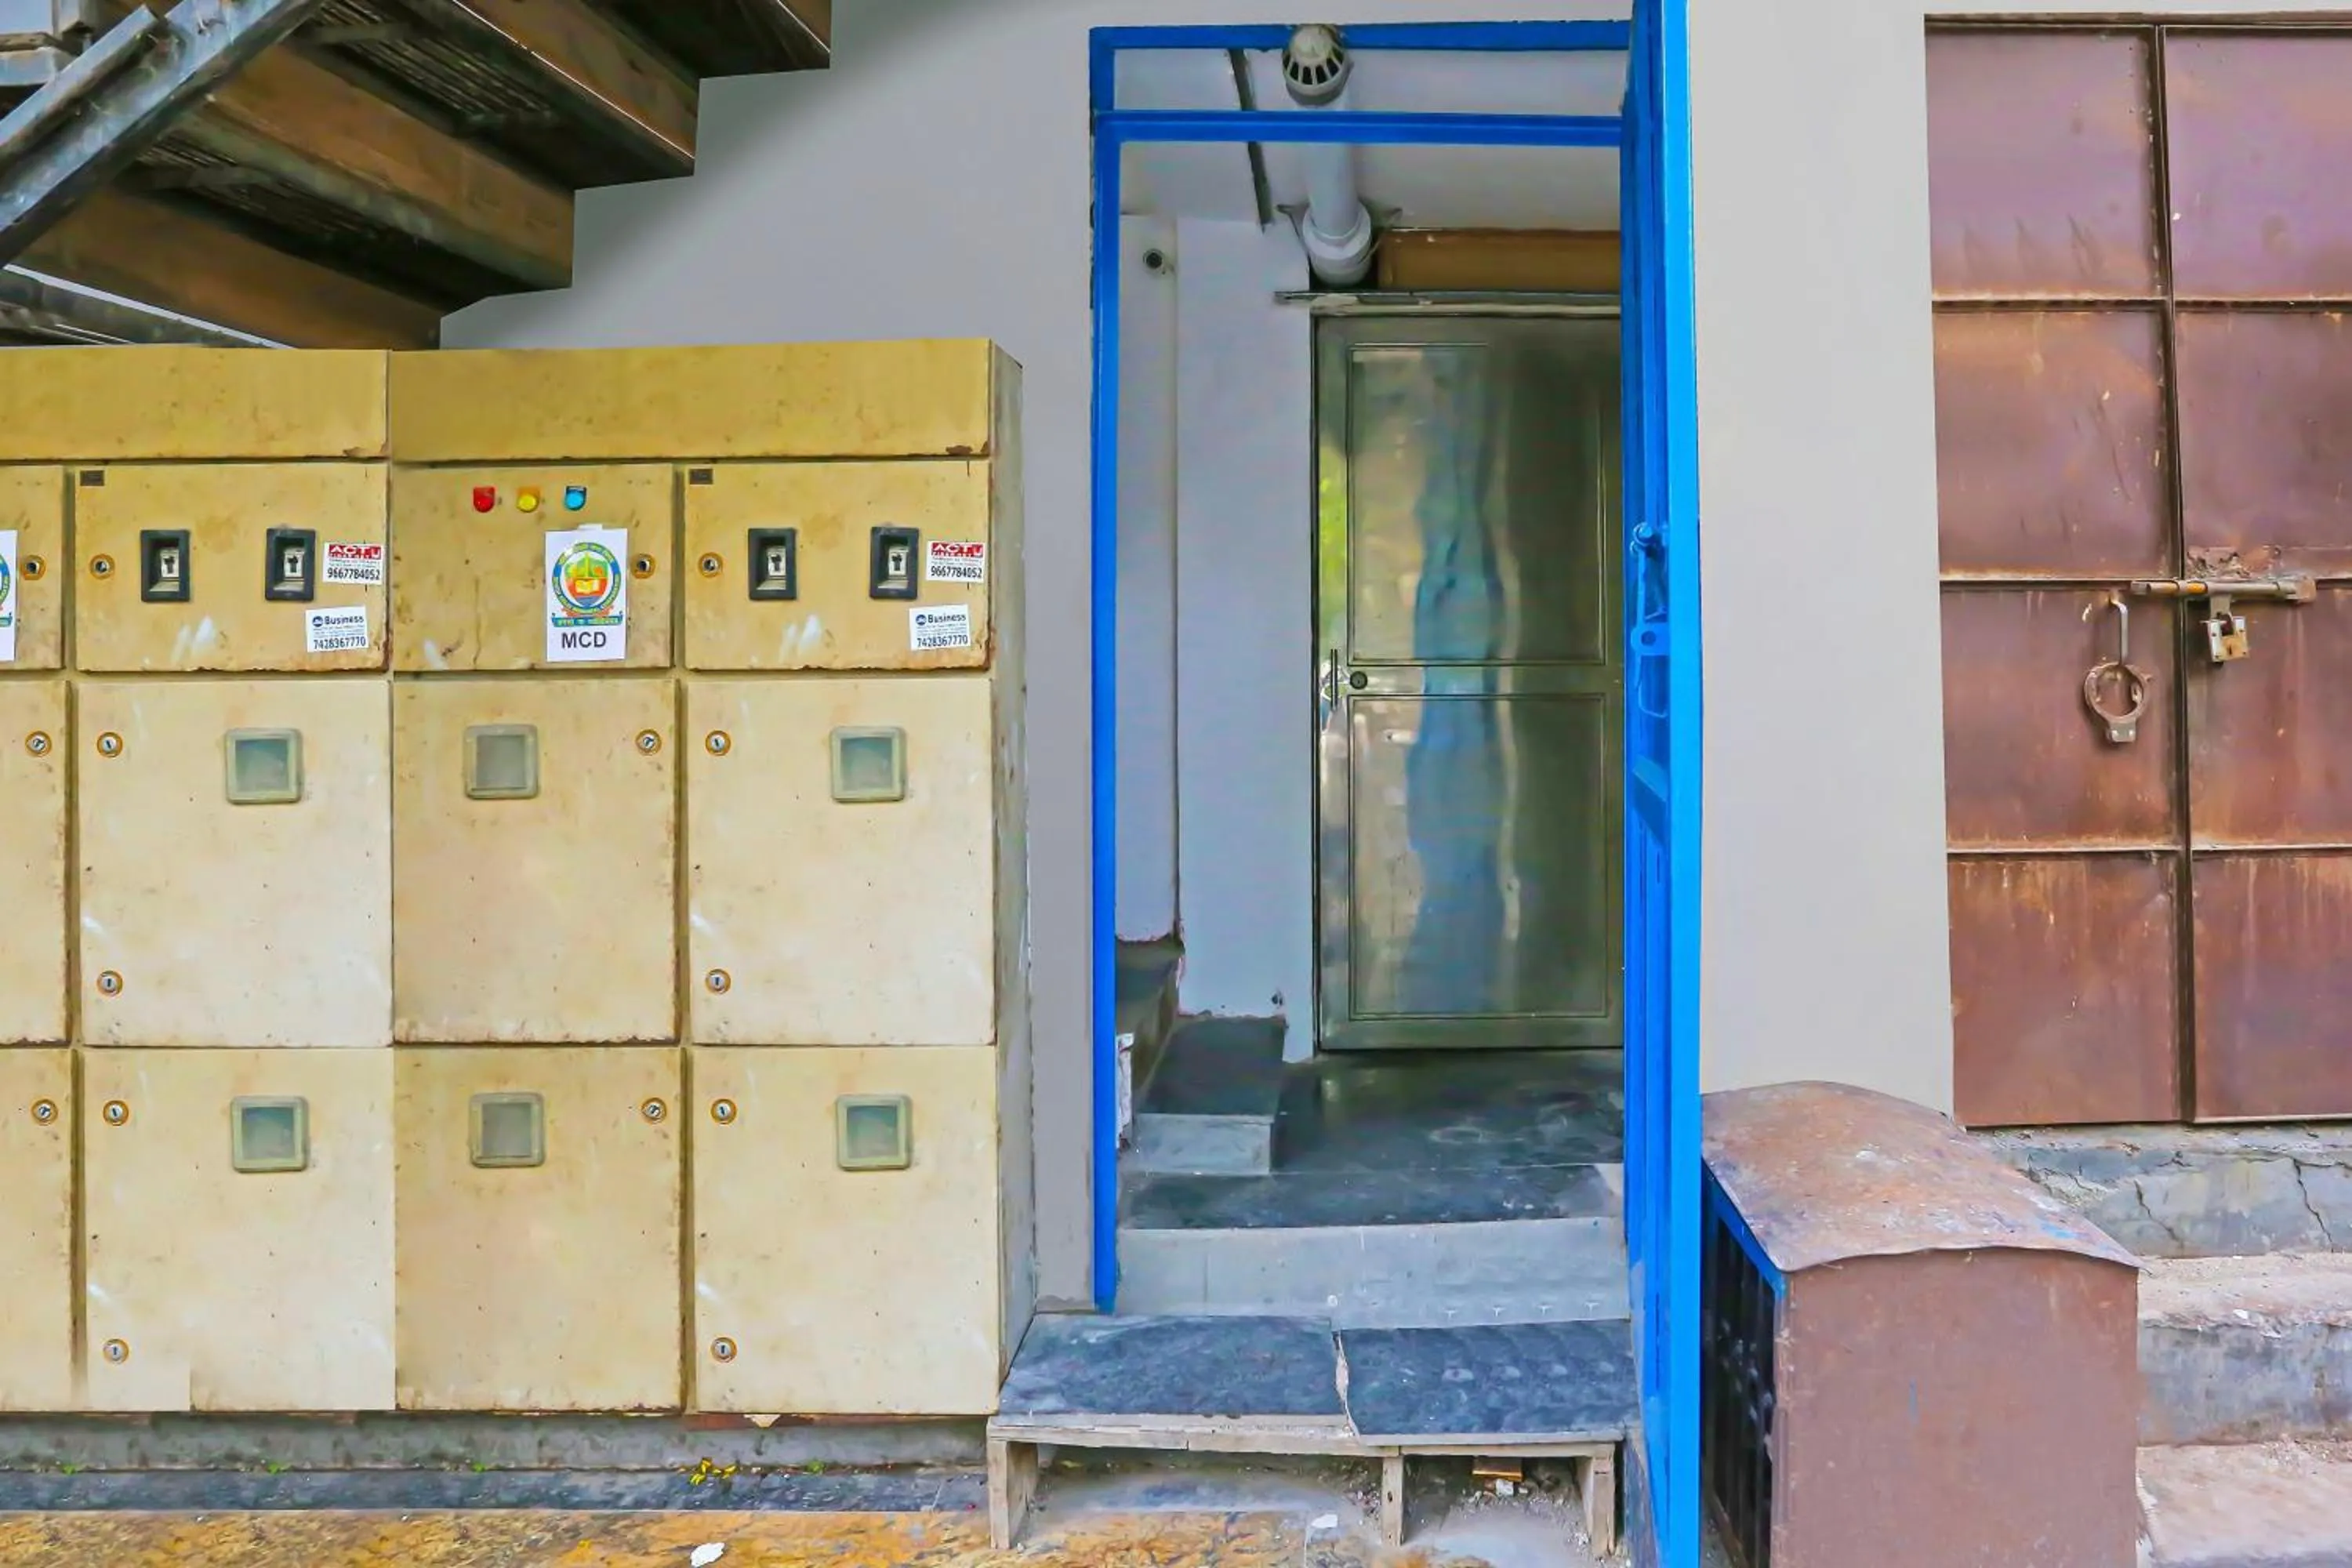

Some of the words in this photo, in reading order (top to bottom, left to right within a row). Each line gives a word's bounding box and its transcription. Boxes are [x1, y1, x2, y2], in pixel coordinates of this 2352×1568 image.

[324, 615, 365, 625] Business
[927, 613, 967, 623] Business
[561, 631, 607, 649] MCD
